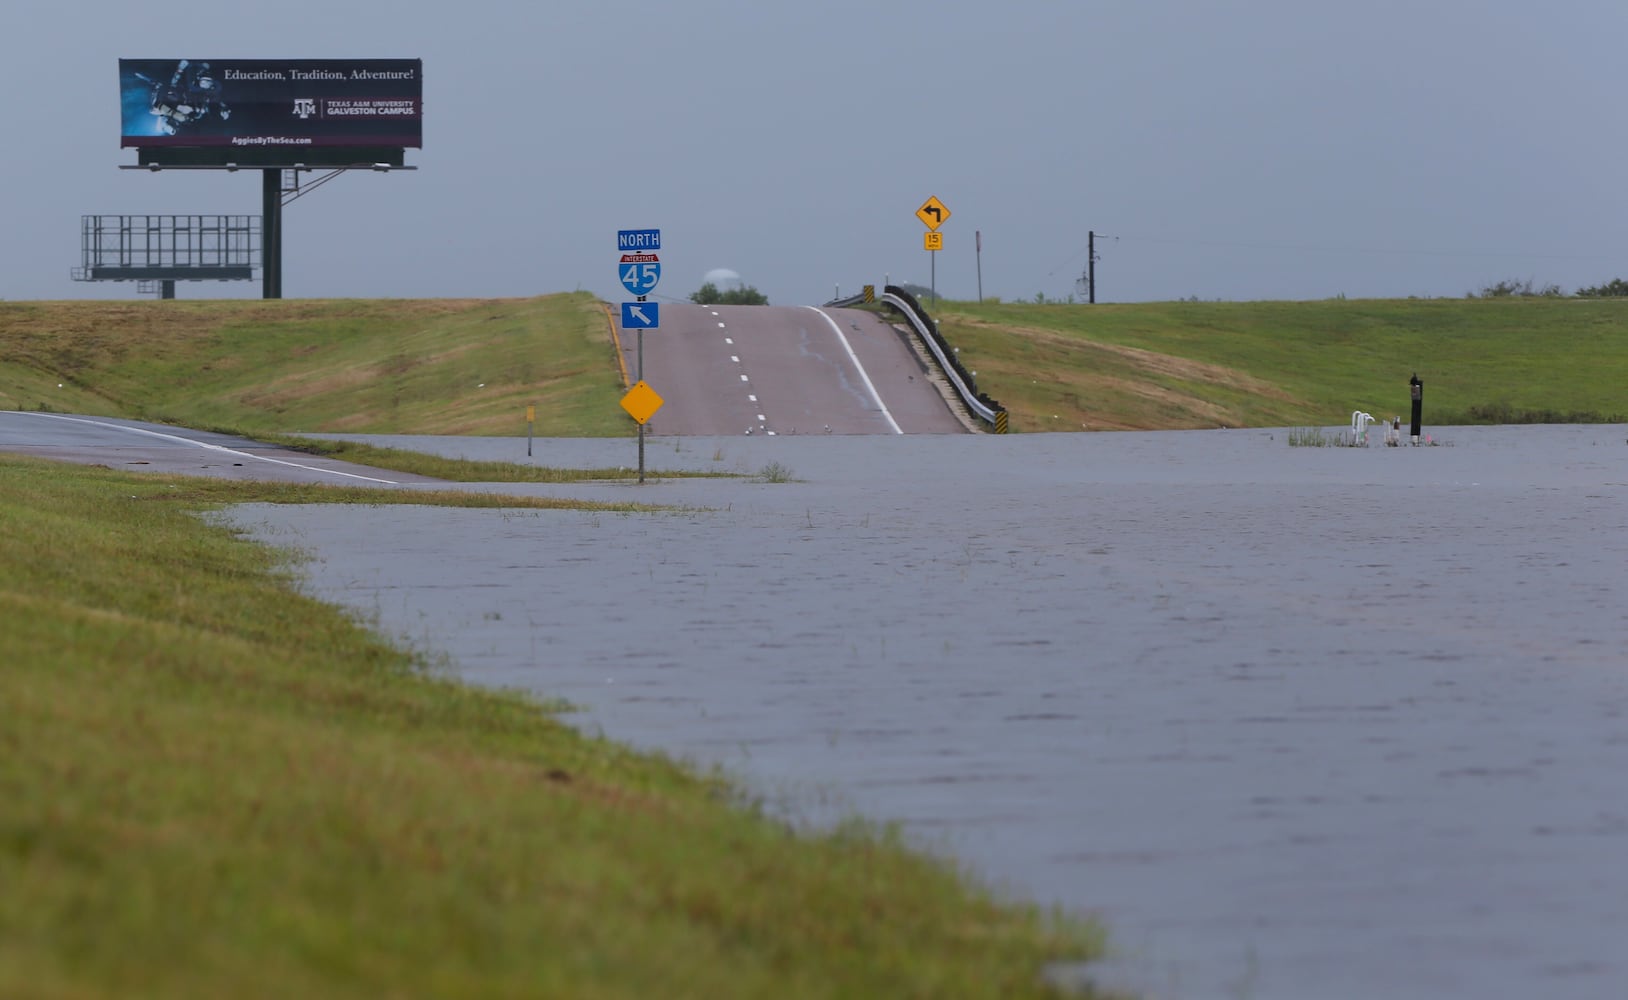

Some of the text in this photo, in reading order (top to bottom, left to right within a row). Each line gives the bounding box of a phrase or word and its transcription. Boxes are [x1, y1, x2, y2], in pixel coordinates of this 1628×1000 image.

[224, 69, 414, 81] Education, Tradition, Adventure!
[327, 107, 414, 115] GALVESTON CAMPUS
[232, 136, 312, 145] AggiesByTheSea.com
[620, 233, 659, 246] NORTH
[928, 234, 939, 243] 15
[622, 264, 658, 287] 45
